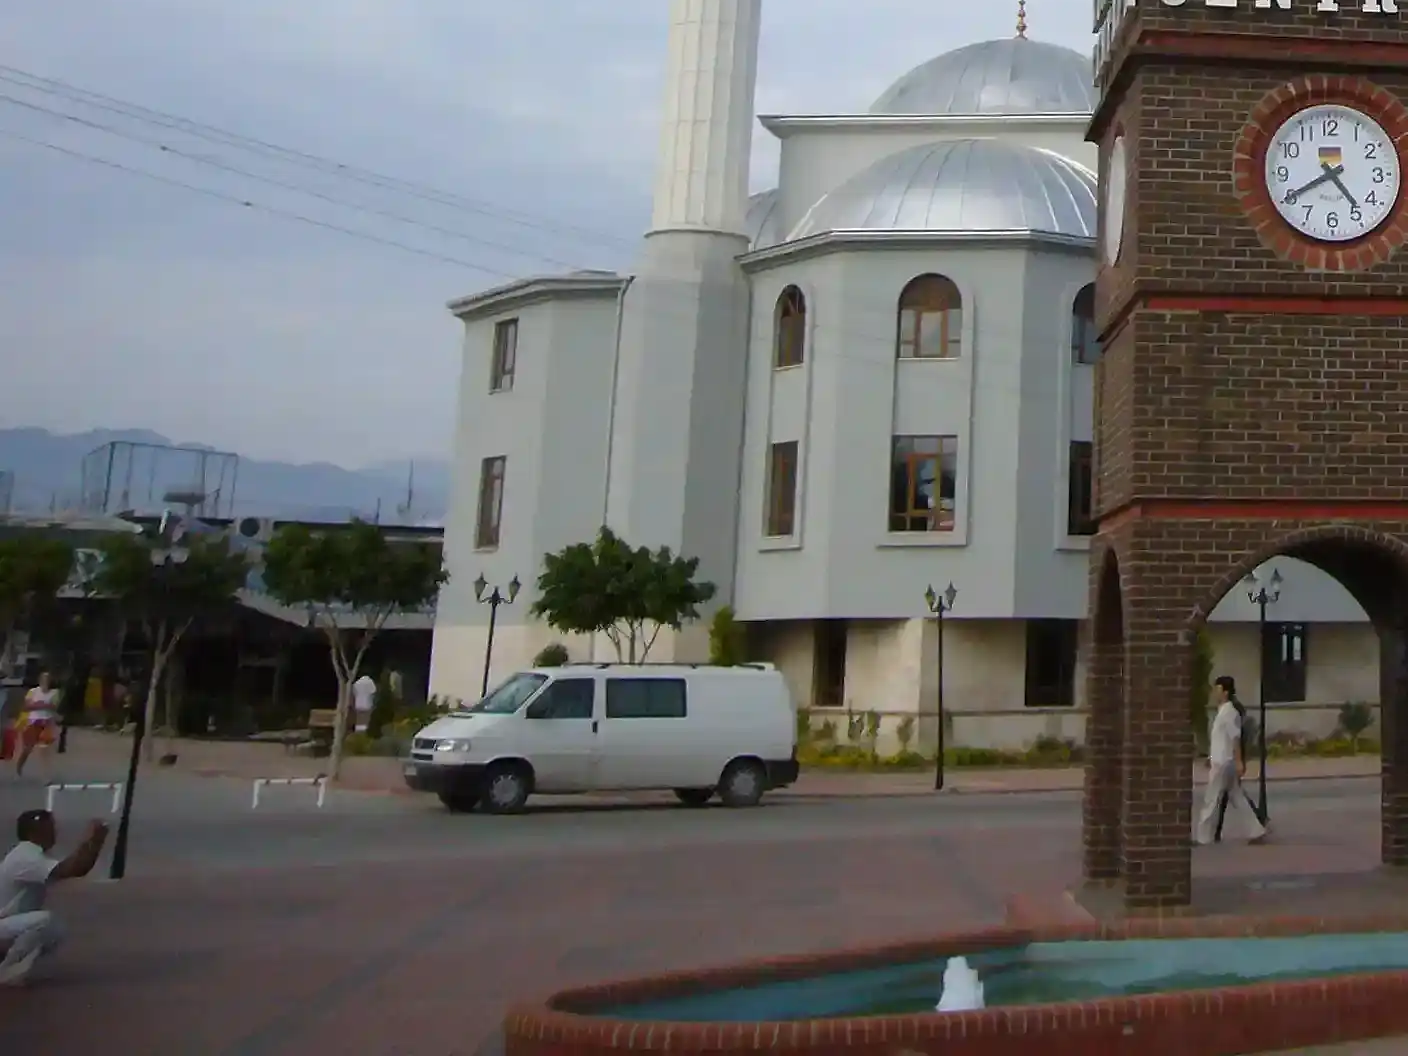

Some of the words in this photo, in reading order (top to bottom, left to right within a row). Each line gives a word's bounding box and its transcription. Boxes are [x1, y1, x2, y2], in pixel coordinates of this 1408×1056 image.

[1300, 125, 1313, 142] 11
[1322, 119, 1339, 137] 12
[1282, 142, 1299, 159] 10
[1364, 143, 1376, 160] 2
[1277, 165, 1289, 183] 9
[1372, 166, 1384, 184] 3
[1364, 190, 1377, 206] 4
[1301, 204, 1314, 221] 7
[1326, 211, 1339, 228] 6
[1350, 205, 1362, 222] 5
